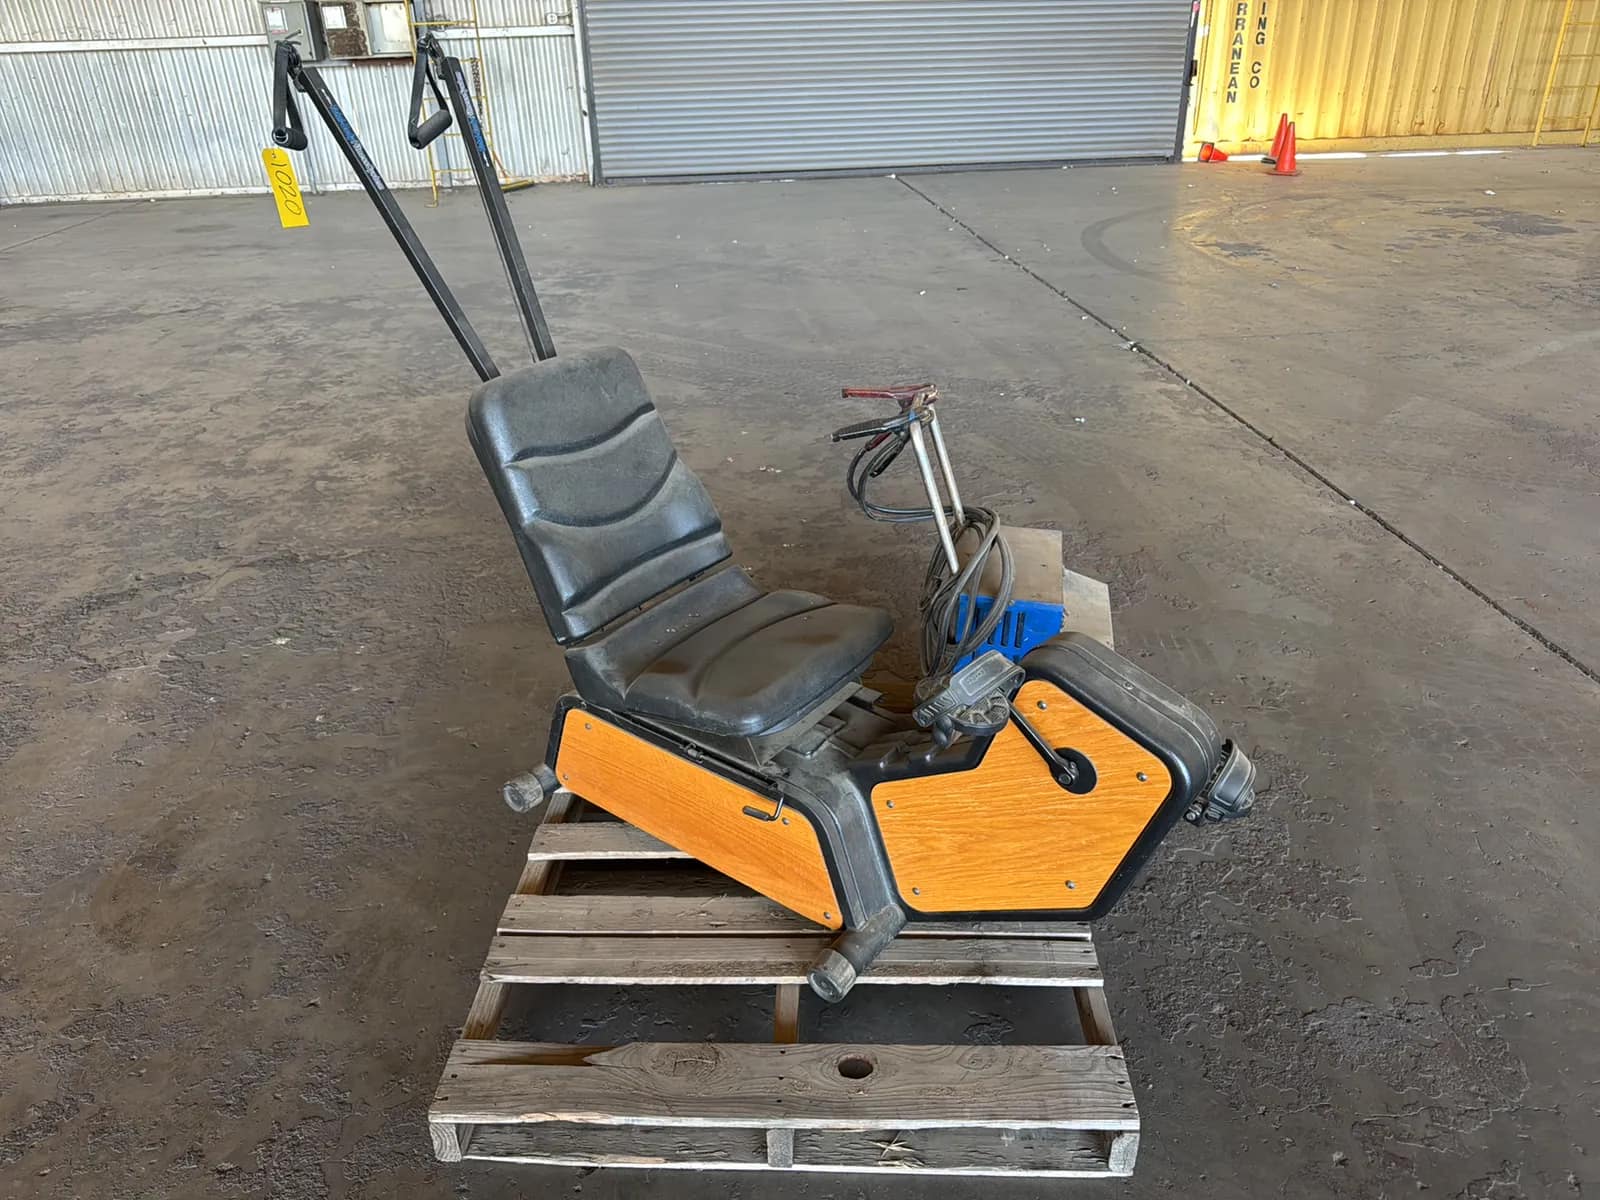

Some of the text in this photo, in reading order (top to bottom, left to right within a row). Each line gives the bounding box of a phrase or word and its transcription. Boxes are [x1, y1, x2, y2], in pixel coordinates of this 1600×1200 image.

[1226, 2, 1248, 104] RRANEAN
[1249, 1, 1267, 89] ING CO
[270, 162, 303, 216] 1020
